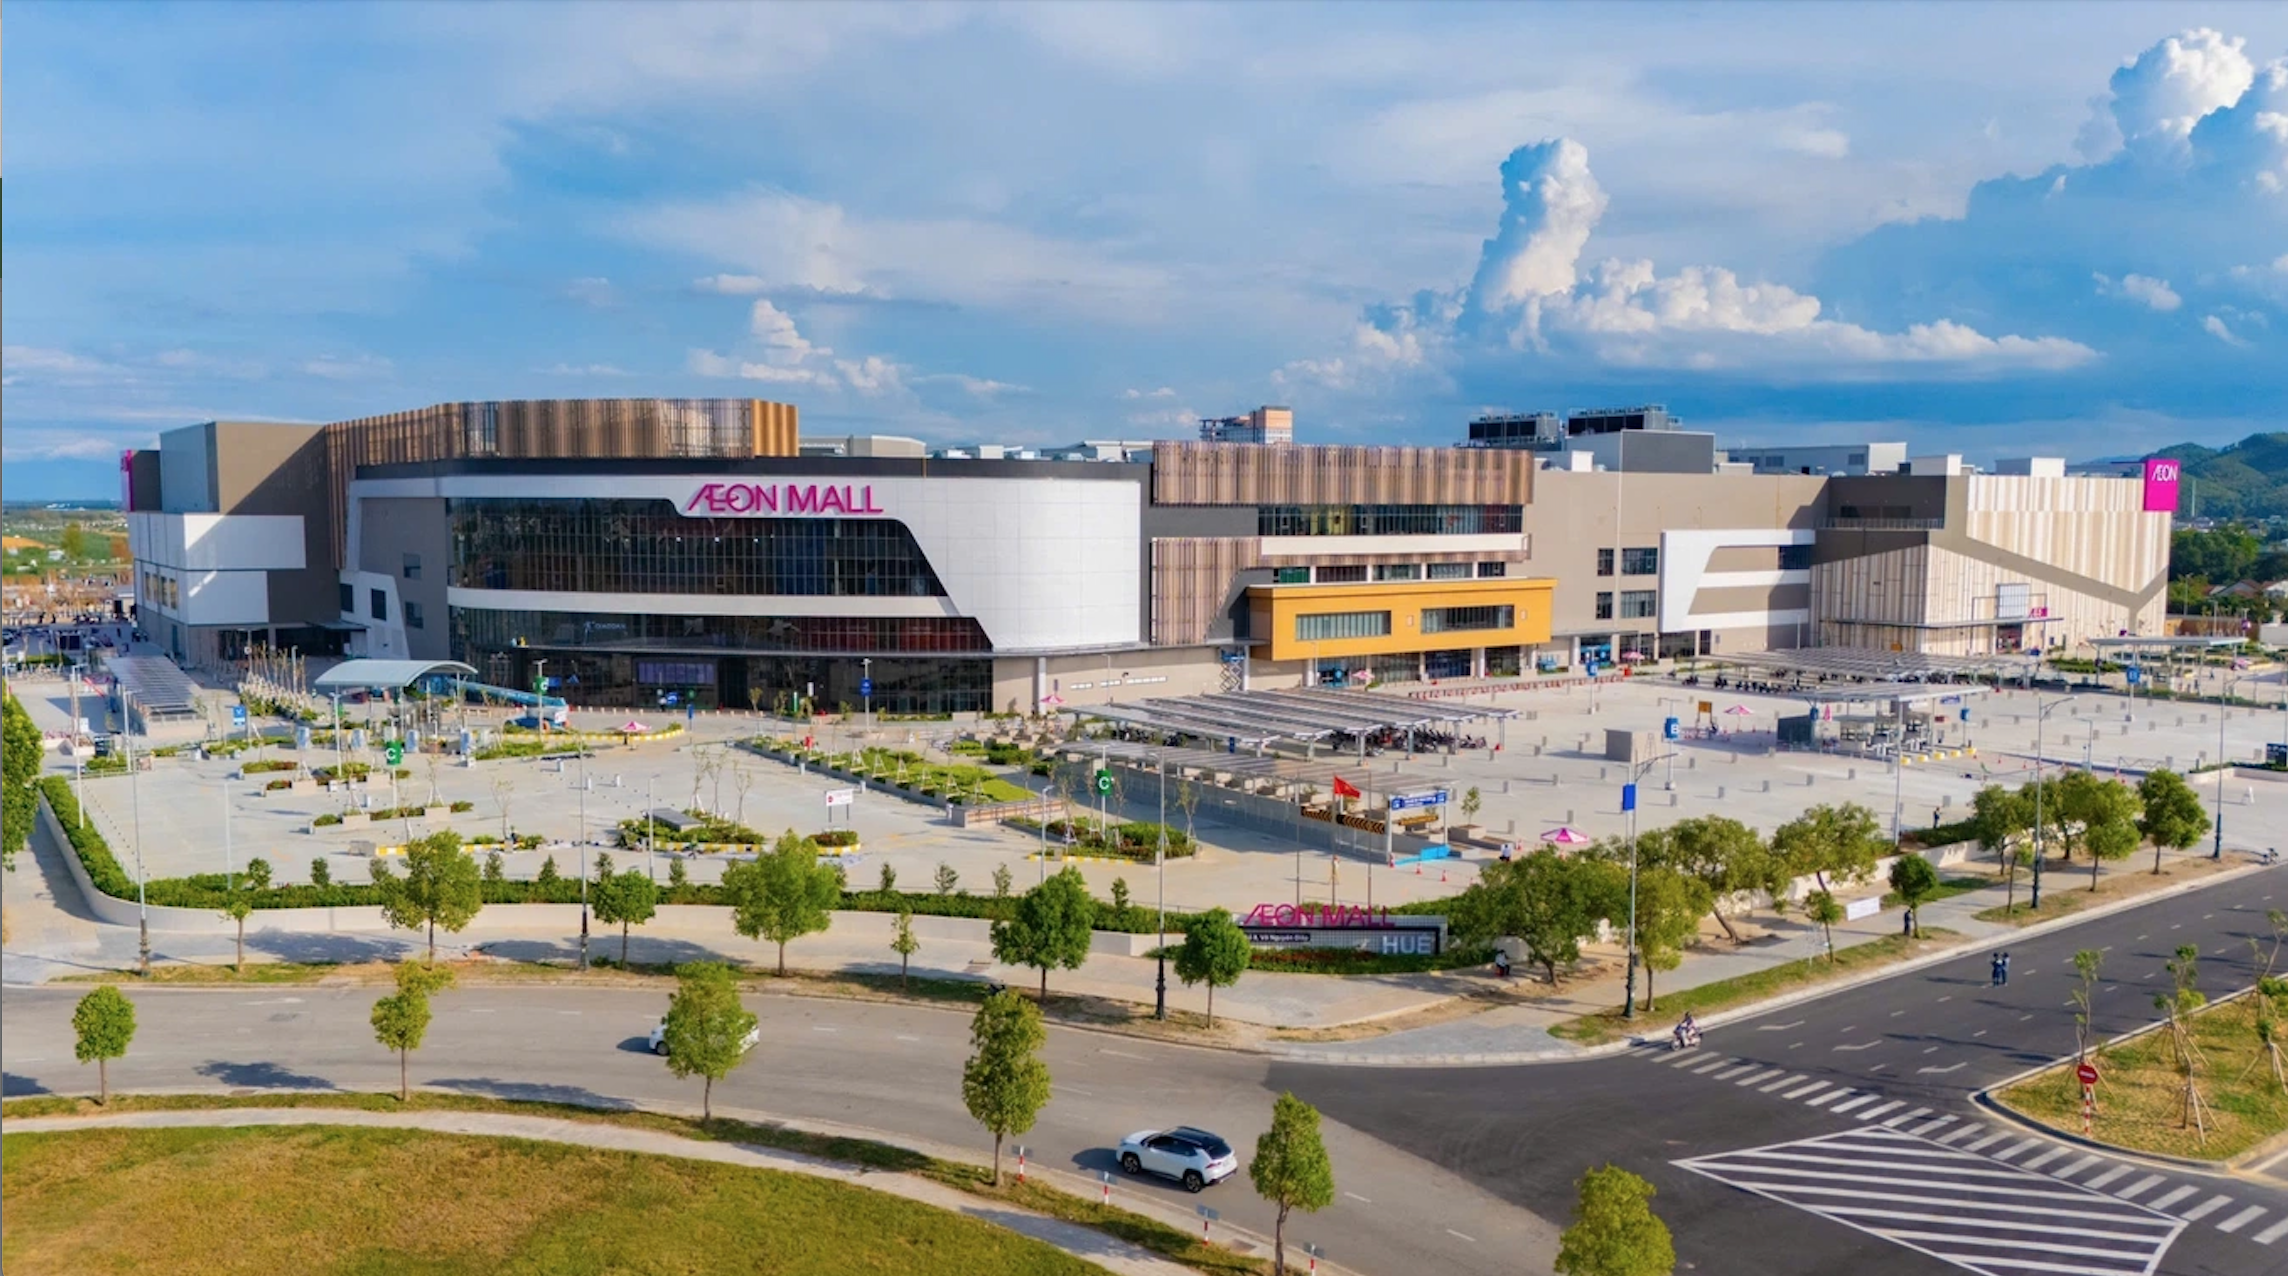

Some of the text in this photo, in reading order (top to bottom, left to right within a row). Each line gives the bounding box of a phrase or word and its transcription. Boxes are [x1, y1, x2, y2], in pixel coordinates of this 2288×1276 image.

[788, 485, 884, 513] MALL
[1670, 723, 1680, 734] B
[385, 747, 396, 760] C
[1098, 776, 1110, 790] C
[1321, 905, 1395, 928] MALL
